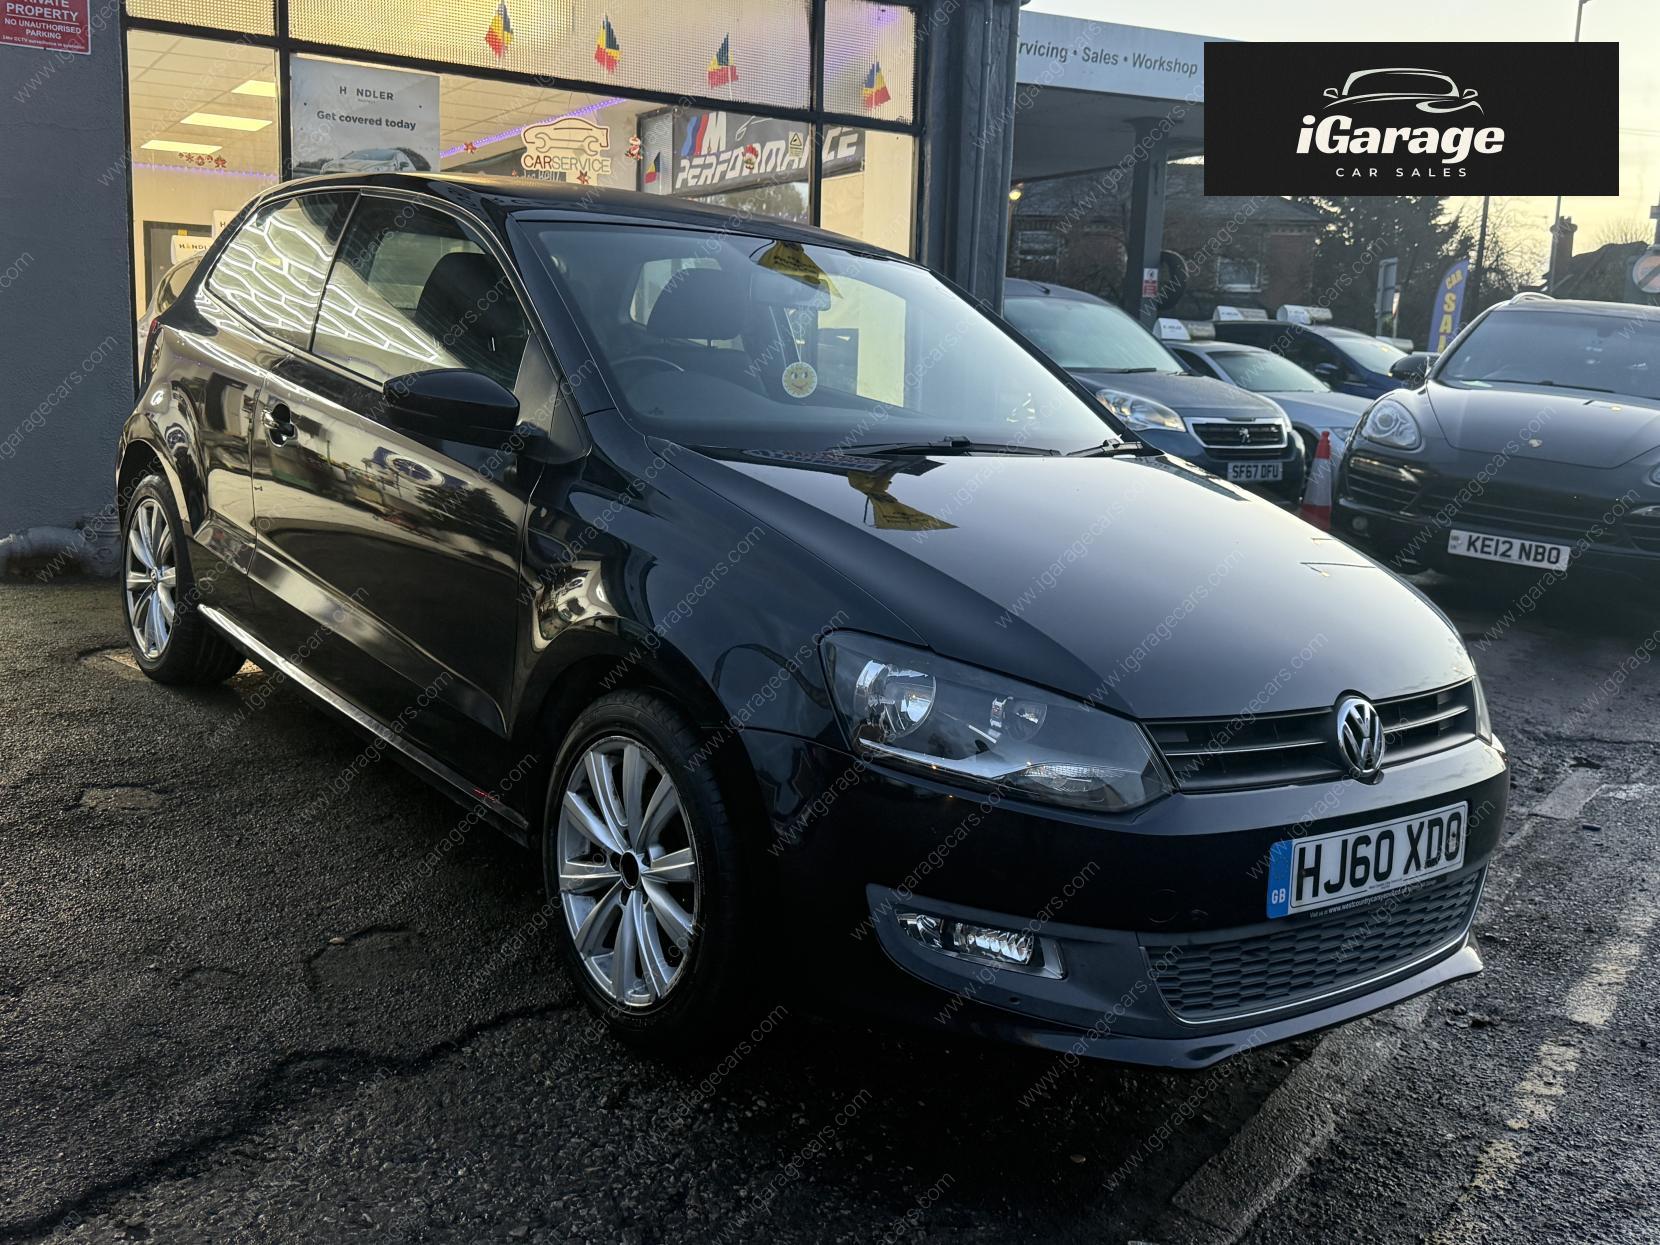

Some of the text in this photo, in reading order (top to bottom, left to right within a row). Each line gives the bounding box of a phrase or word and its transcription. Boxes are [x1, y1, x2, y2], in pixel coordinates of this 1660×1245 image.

[6, 2, 79, 22] PROPERTY
[4, 17, 82, 34] NO UNAUTHORISED
[25, 29, 62, 40] PARKING
[1082, 46, 1119, 66] Sales
[1132, 52, 1198, 78] Workshop
[316, 110, 416, 131] Get covered today
[1232, 464, 1280, 479] SF67 DFU
[1466, 534, 1514, 558] KE12
[1518, 542, 1561, 565] NBO
[1296, 829, 1395, 902] HJ60
[1403, 811, 1462, 875] XDO
[1271, 887, 1286, 905] GB
